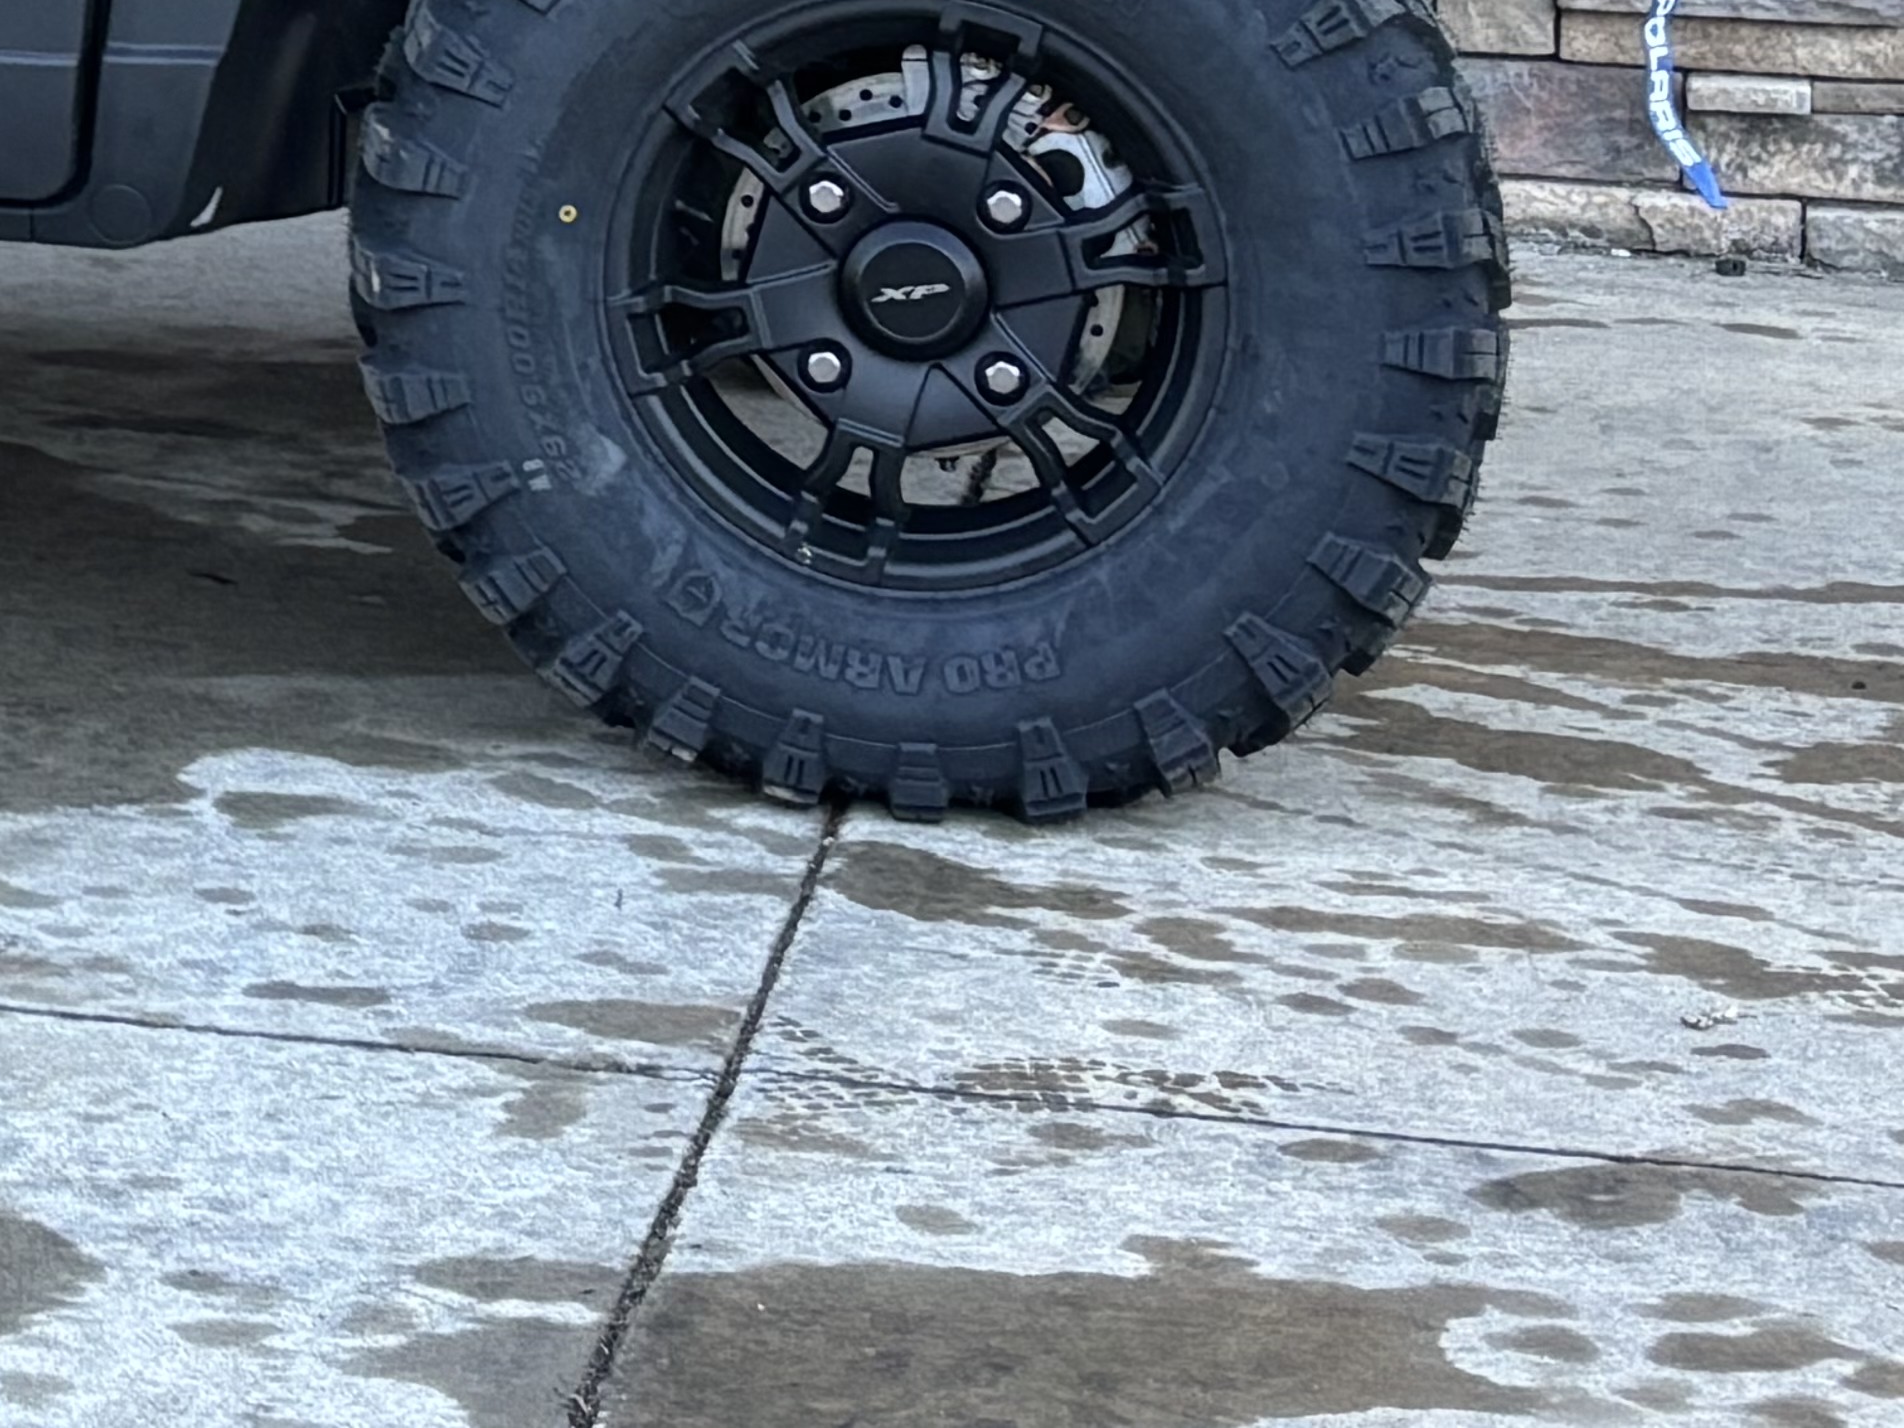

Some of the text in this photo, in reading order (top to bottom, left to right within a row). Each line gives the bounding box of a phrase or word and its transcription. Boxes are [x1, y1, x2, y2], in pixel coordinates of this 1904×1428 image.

[871, 283, 950, 302] XP
[718, 610, 1063, 698] PRO ARMOR
